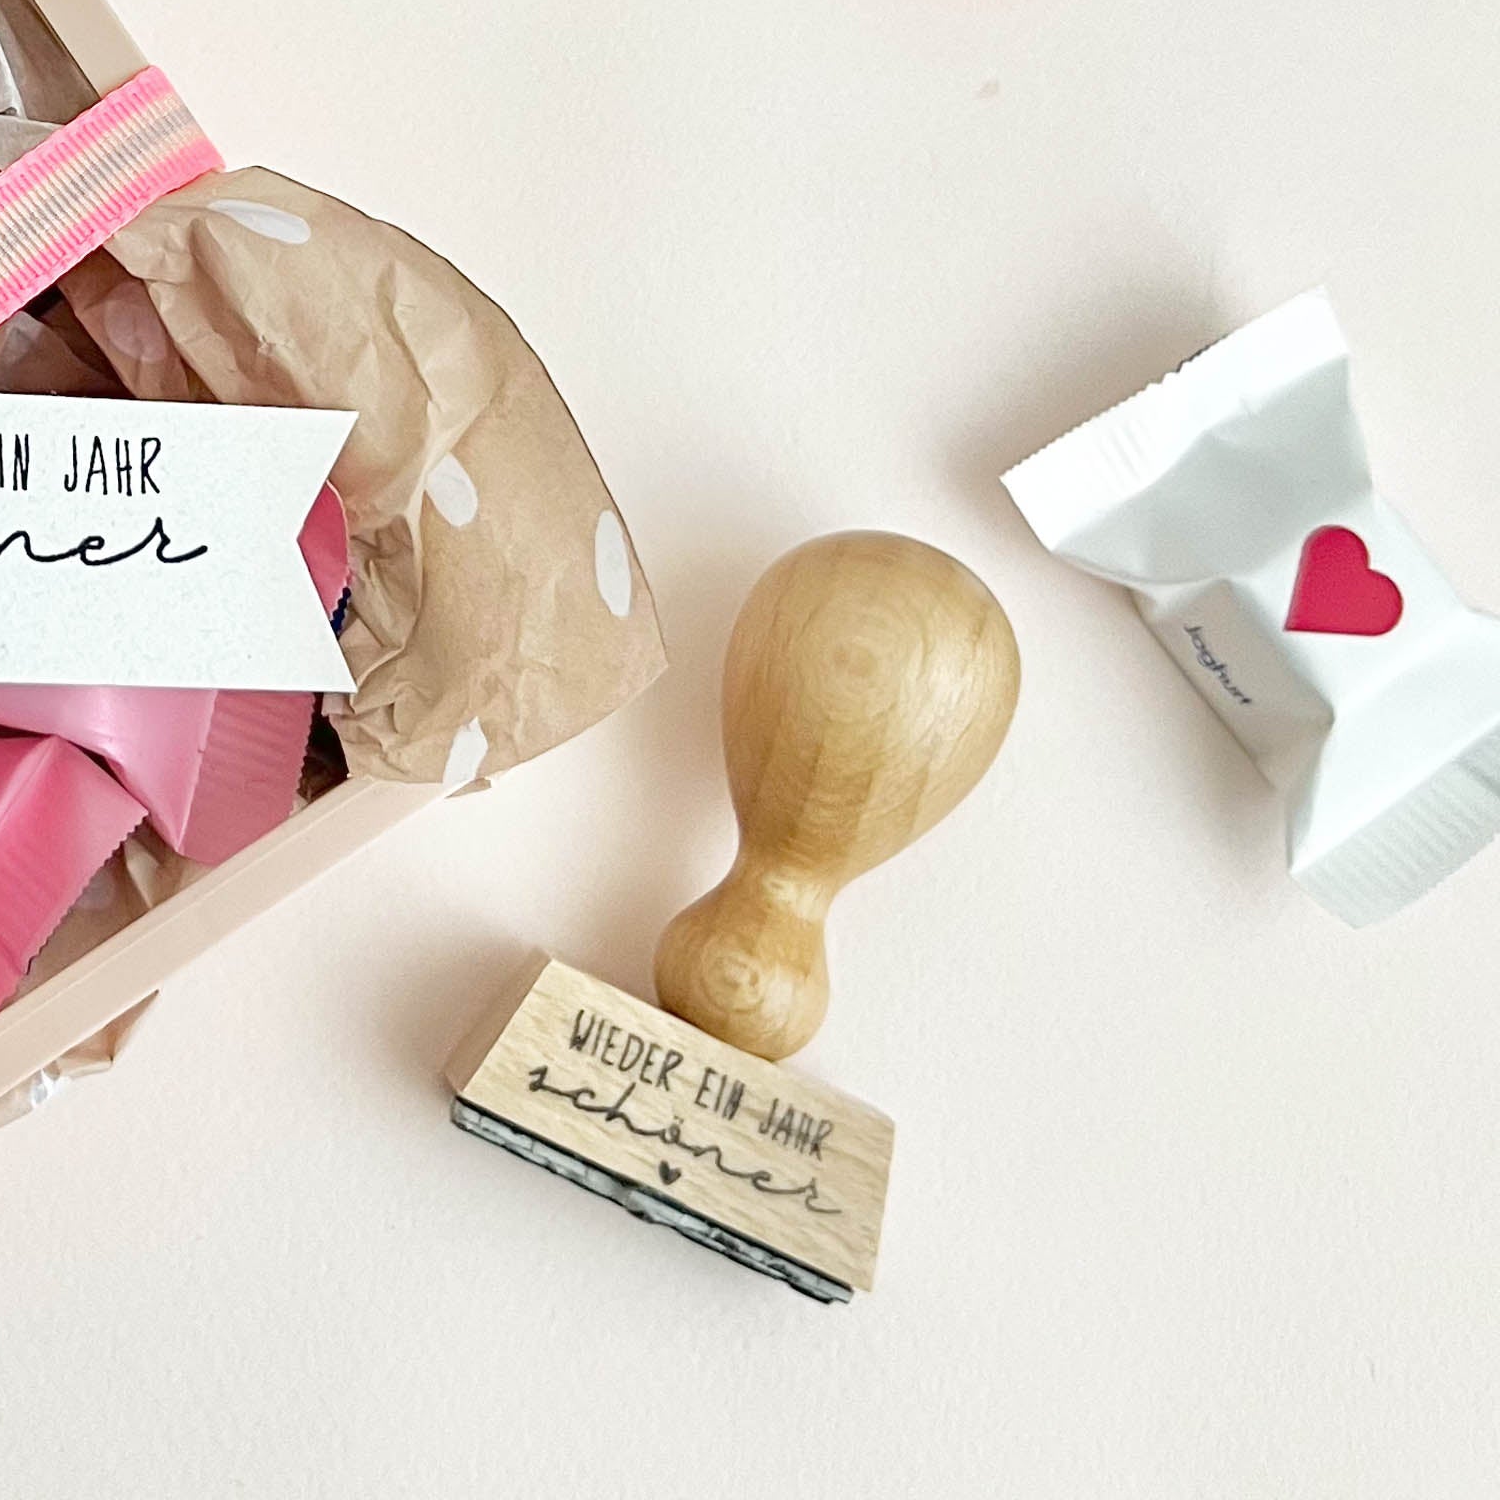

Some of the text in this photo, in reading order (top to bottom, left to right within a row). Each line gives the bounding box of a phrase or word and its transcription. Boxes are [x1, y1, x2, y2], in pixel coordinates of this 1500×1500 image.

[64, 435, 162, 496] JAHR
[527, 1065, 843, 1214] schöner
[569, 1009, 833, 1162] WIEDER EIN JAHR
